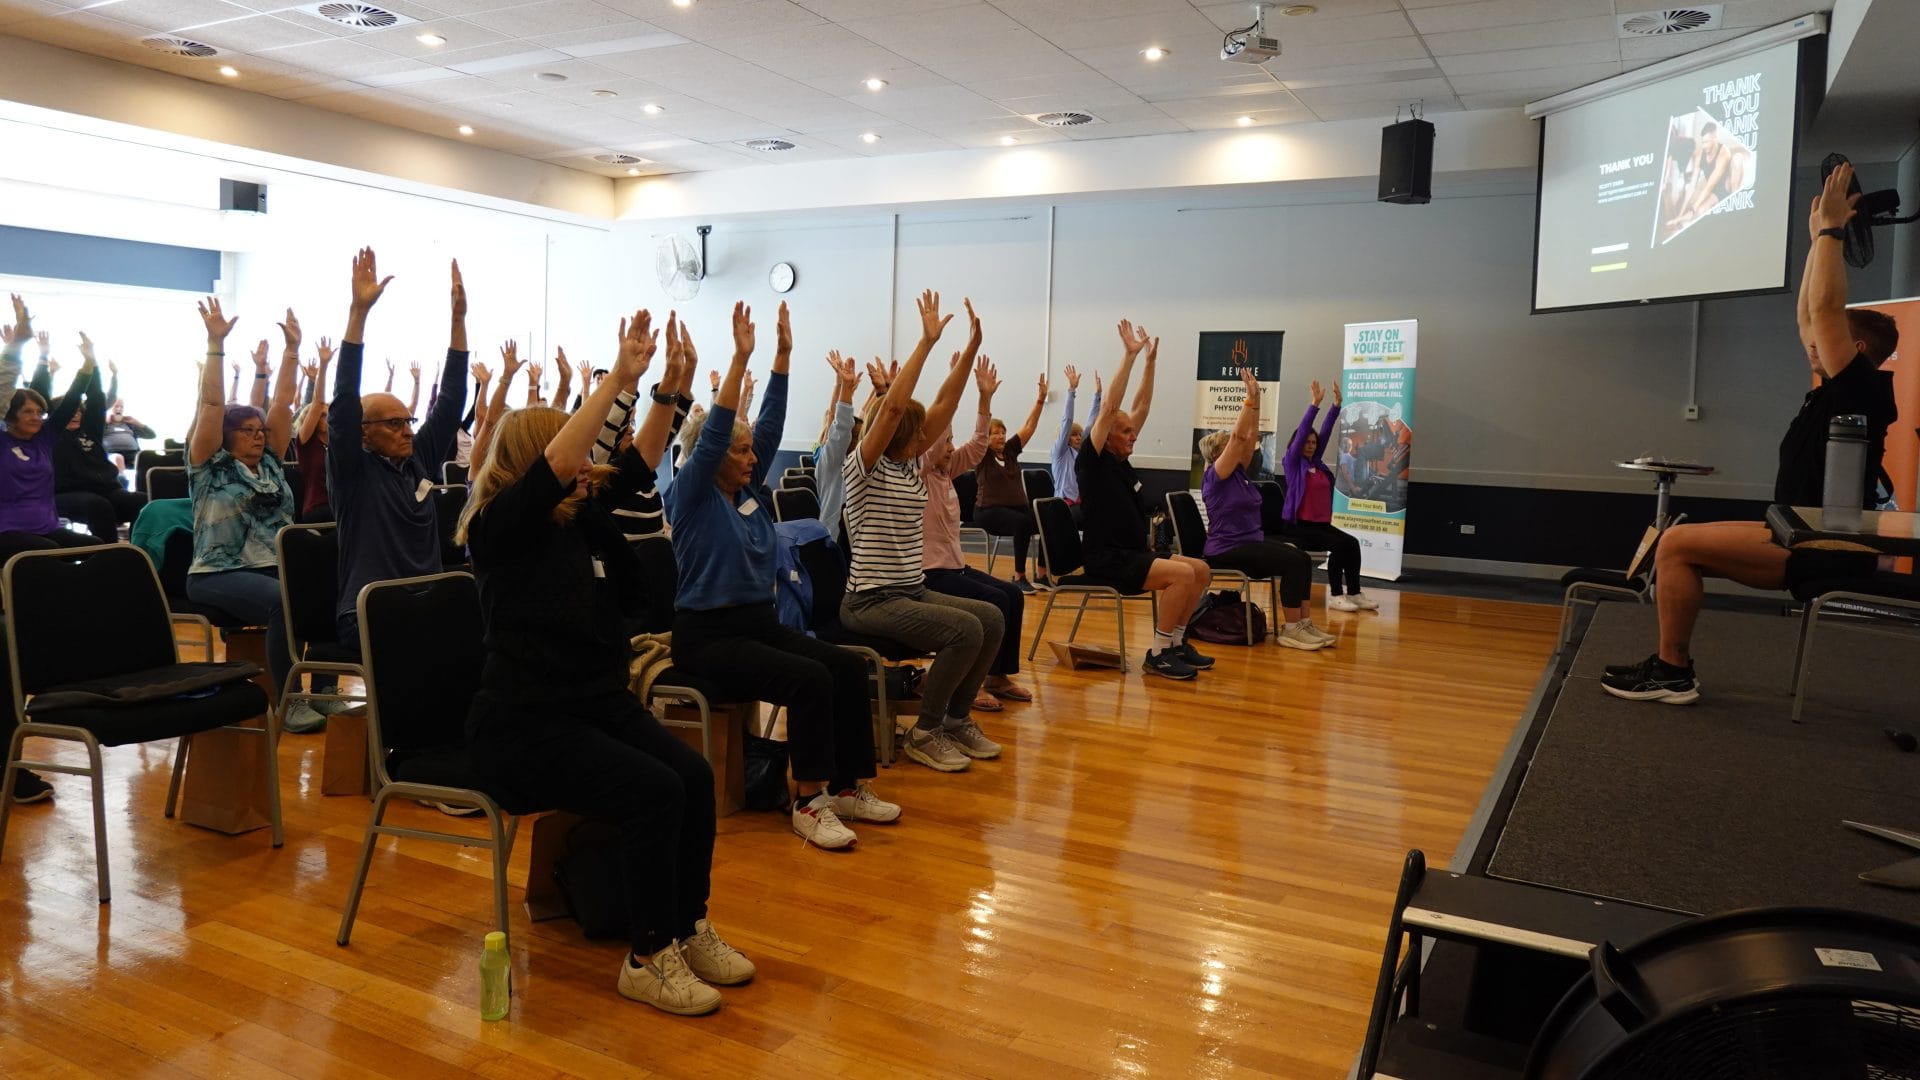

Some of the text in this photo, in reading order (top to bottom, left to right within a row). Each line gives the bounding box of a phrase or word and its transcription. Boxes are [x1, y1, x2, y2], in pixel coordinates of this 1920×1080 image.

[1703, 73, 1761, 104] THANK
[1722, 93, 1759, 118] YOU
[1719, 112, 1759, 134] ANK
[1600, 153, 1654, 175] THANK YOU
[1359, 329, 1399, 342] STAY ON
[1353, 341, 1403, 354] YOUR FEET
[1353, 372, 1371, 380] LITTLE
[1388, 381, 1404, 389] WAY
